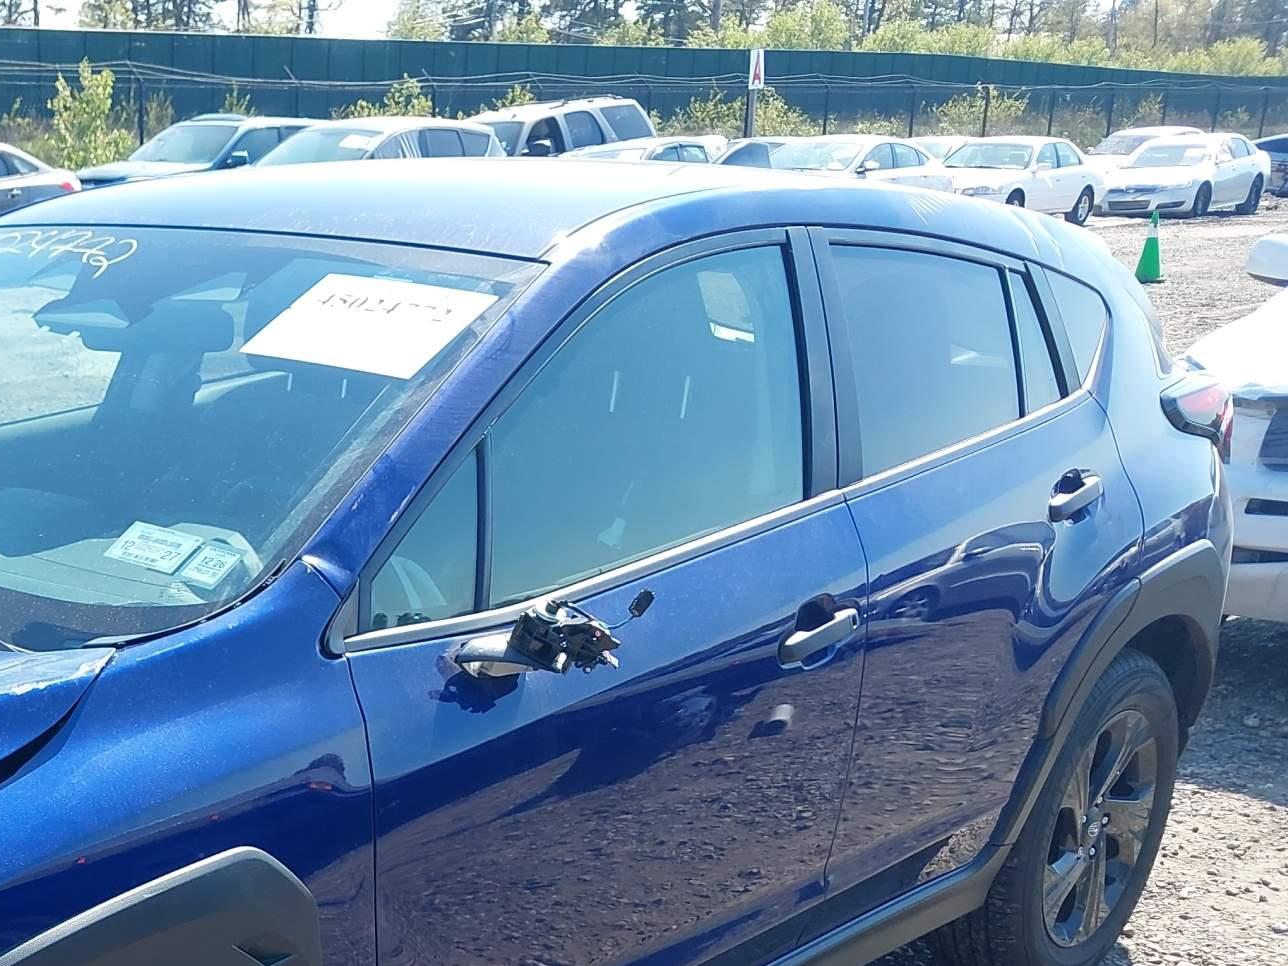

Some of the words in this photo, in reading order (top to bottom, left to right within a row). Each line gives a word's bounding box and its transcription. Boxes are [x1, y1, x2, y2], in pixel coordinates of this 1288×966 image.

[752, 50, 761, 86] A
[120, 539, 136, 551] 12
[159, 550, 182, 562] 27
[201, 555, 214, 565] 12
[215, 560, 227, 569] 26
